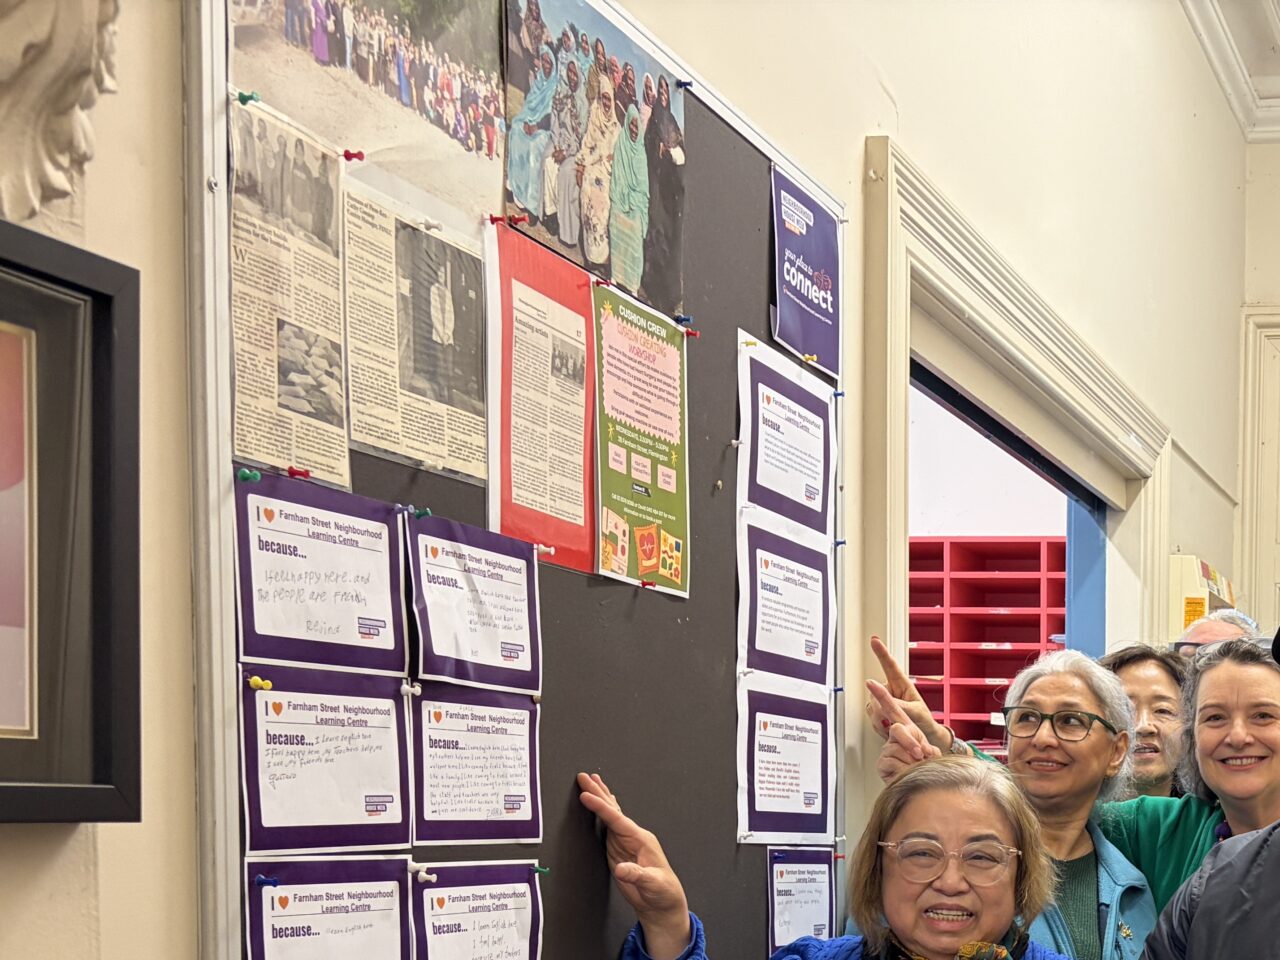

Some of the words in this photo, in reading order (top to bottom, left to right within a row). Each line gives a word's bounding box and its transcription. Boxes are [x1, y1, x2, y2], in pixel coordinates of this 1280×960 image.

[783, 261, 834, 314] connect
[619, 304, 647, 329] CUSHION
[647, 321, 667, 338] CREW
[279, 509, 310, 525] Farnham
[311, 516, 332, 530] Street
[334, 521, 383, 540] Neighbourhood
[307, 528, 337, 544] Learning
[338, 534, 359, 547] Centre
[258, 535, 307, 559] because...
[441, 547, 467, 561] Farnham
[467, 553, 483, 565] Street
[484, 558, 522, 575] Neighbourhood
[426, 569, 464, 590] because...
[463, 564, 486, 578] Learning
[487, 569, 504, 581] Centre
[287, 701, 318, 713] Farnham
[319, 703, 340, 713] Street
[343, 704, 391, 716] Neighbourhood
[315, 715, 346, 727] Learning
[347, 717, 368, 727] Centre
[445, 710, 470, 720] Farnham
[470, 712, 487, 721] Street
[488, 714, 525, 725] Neighbourhood
[466, 723, 491, 734] Learning
[491, 726, 508, 735] Centre
[266, 729, 314, 747] because...
[428, 735, 466, 751] because...
[293, 893, 324, 903] Farnham
[325, 891, 344, 901] Street
[347, 889, 394, 901] Neighbourhood
[448, 894, 471, 903] Farnham
[471, 893, 487, 902] Street
[489, 890, 526, 901] Neighbourhood
[321, 904, 350, 914] Learning
[351, 903, 371, 912] Centre
[468, 904, 491, 913] Learning
[491, 902, 508, 910] Centre
[272, 923, 321, 939] because...
[432, 922, 468, 935] because...
